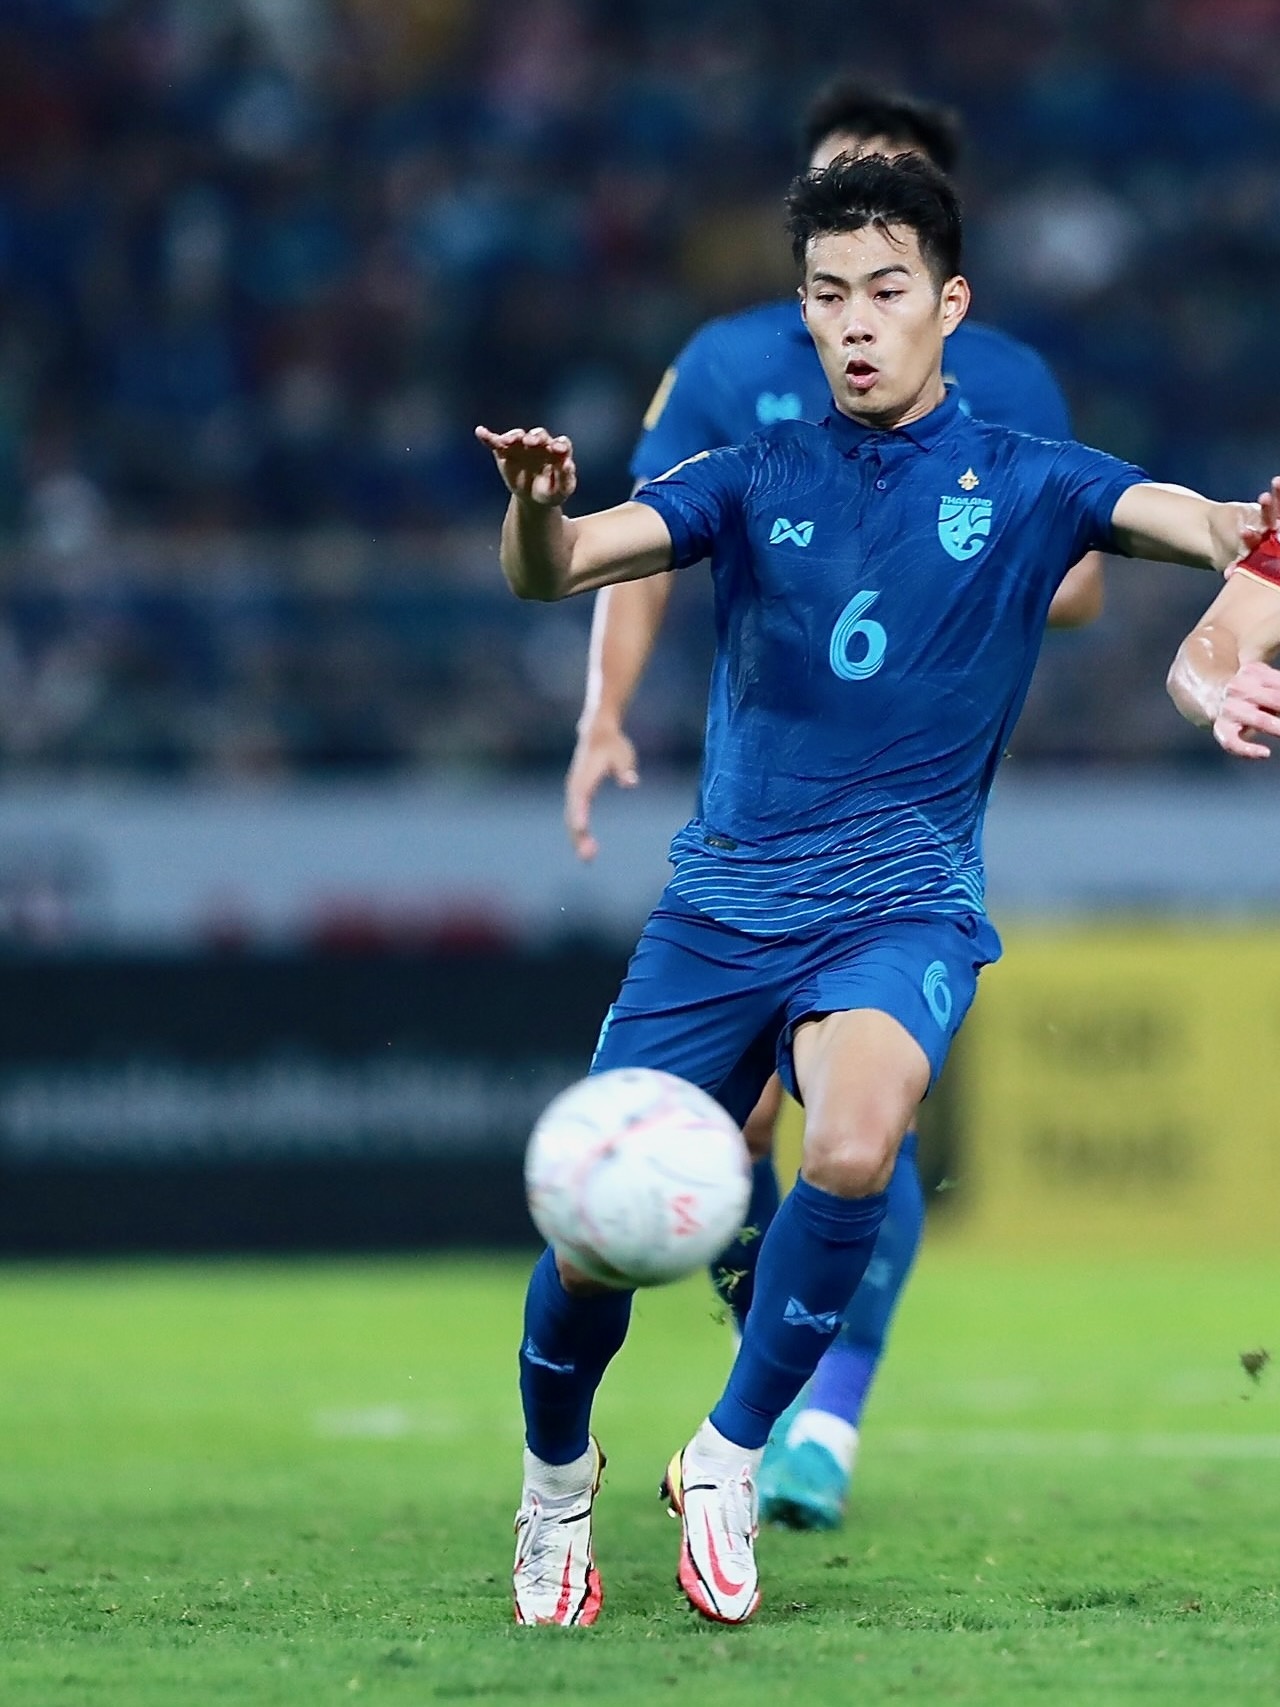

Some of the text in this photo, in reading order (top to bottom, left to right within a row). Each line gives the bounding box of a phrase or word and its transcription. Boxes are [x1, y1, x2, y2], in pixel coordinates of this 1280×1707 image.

[940, 495, 993, 508] THAILAND
[829, 590, 887, 681] 6
[922, 959, 953, 1032] 6
